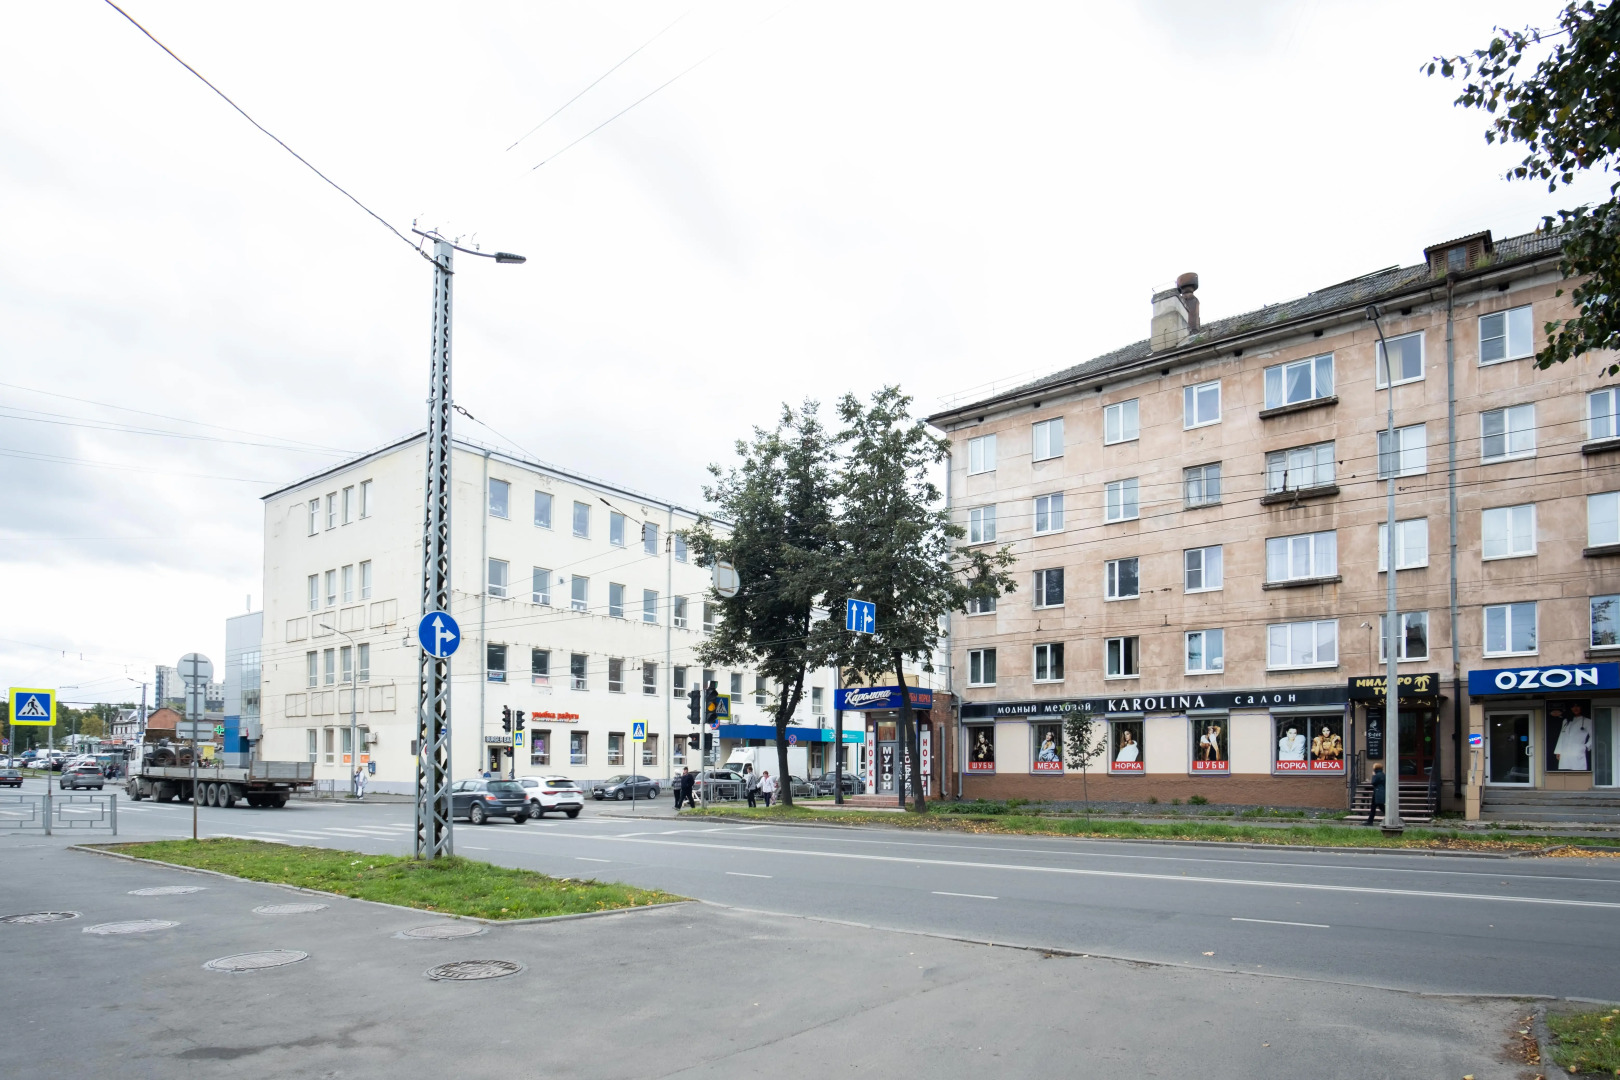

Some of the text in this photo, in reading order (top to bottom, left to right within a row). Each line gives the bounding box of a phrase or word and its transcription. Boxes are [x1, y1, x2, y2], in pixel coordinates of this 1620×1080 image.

[1356, 677, 1412, 687] МИЛАРО
[1495, 667, 1598, 690] OZON
[1373, 687, 1388, 695] ТУ
[1108, 696, 1205, 711] KAROLINA
[1235, 694, 1296, 704] салон
[882, 746, 892, 790] МУТОН
[1037, 762, 1060, 770] МЕХА
[1114, 762, 1142, 770] НОРКА
[1196, 761, 1225, 769] ШУБЫ
[1276, 761, 1307, 770] НОРКА
[1313, 761, 1340, 769] МЕХА
